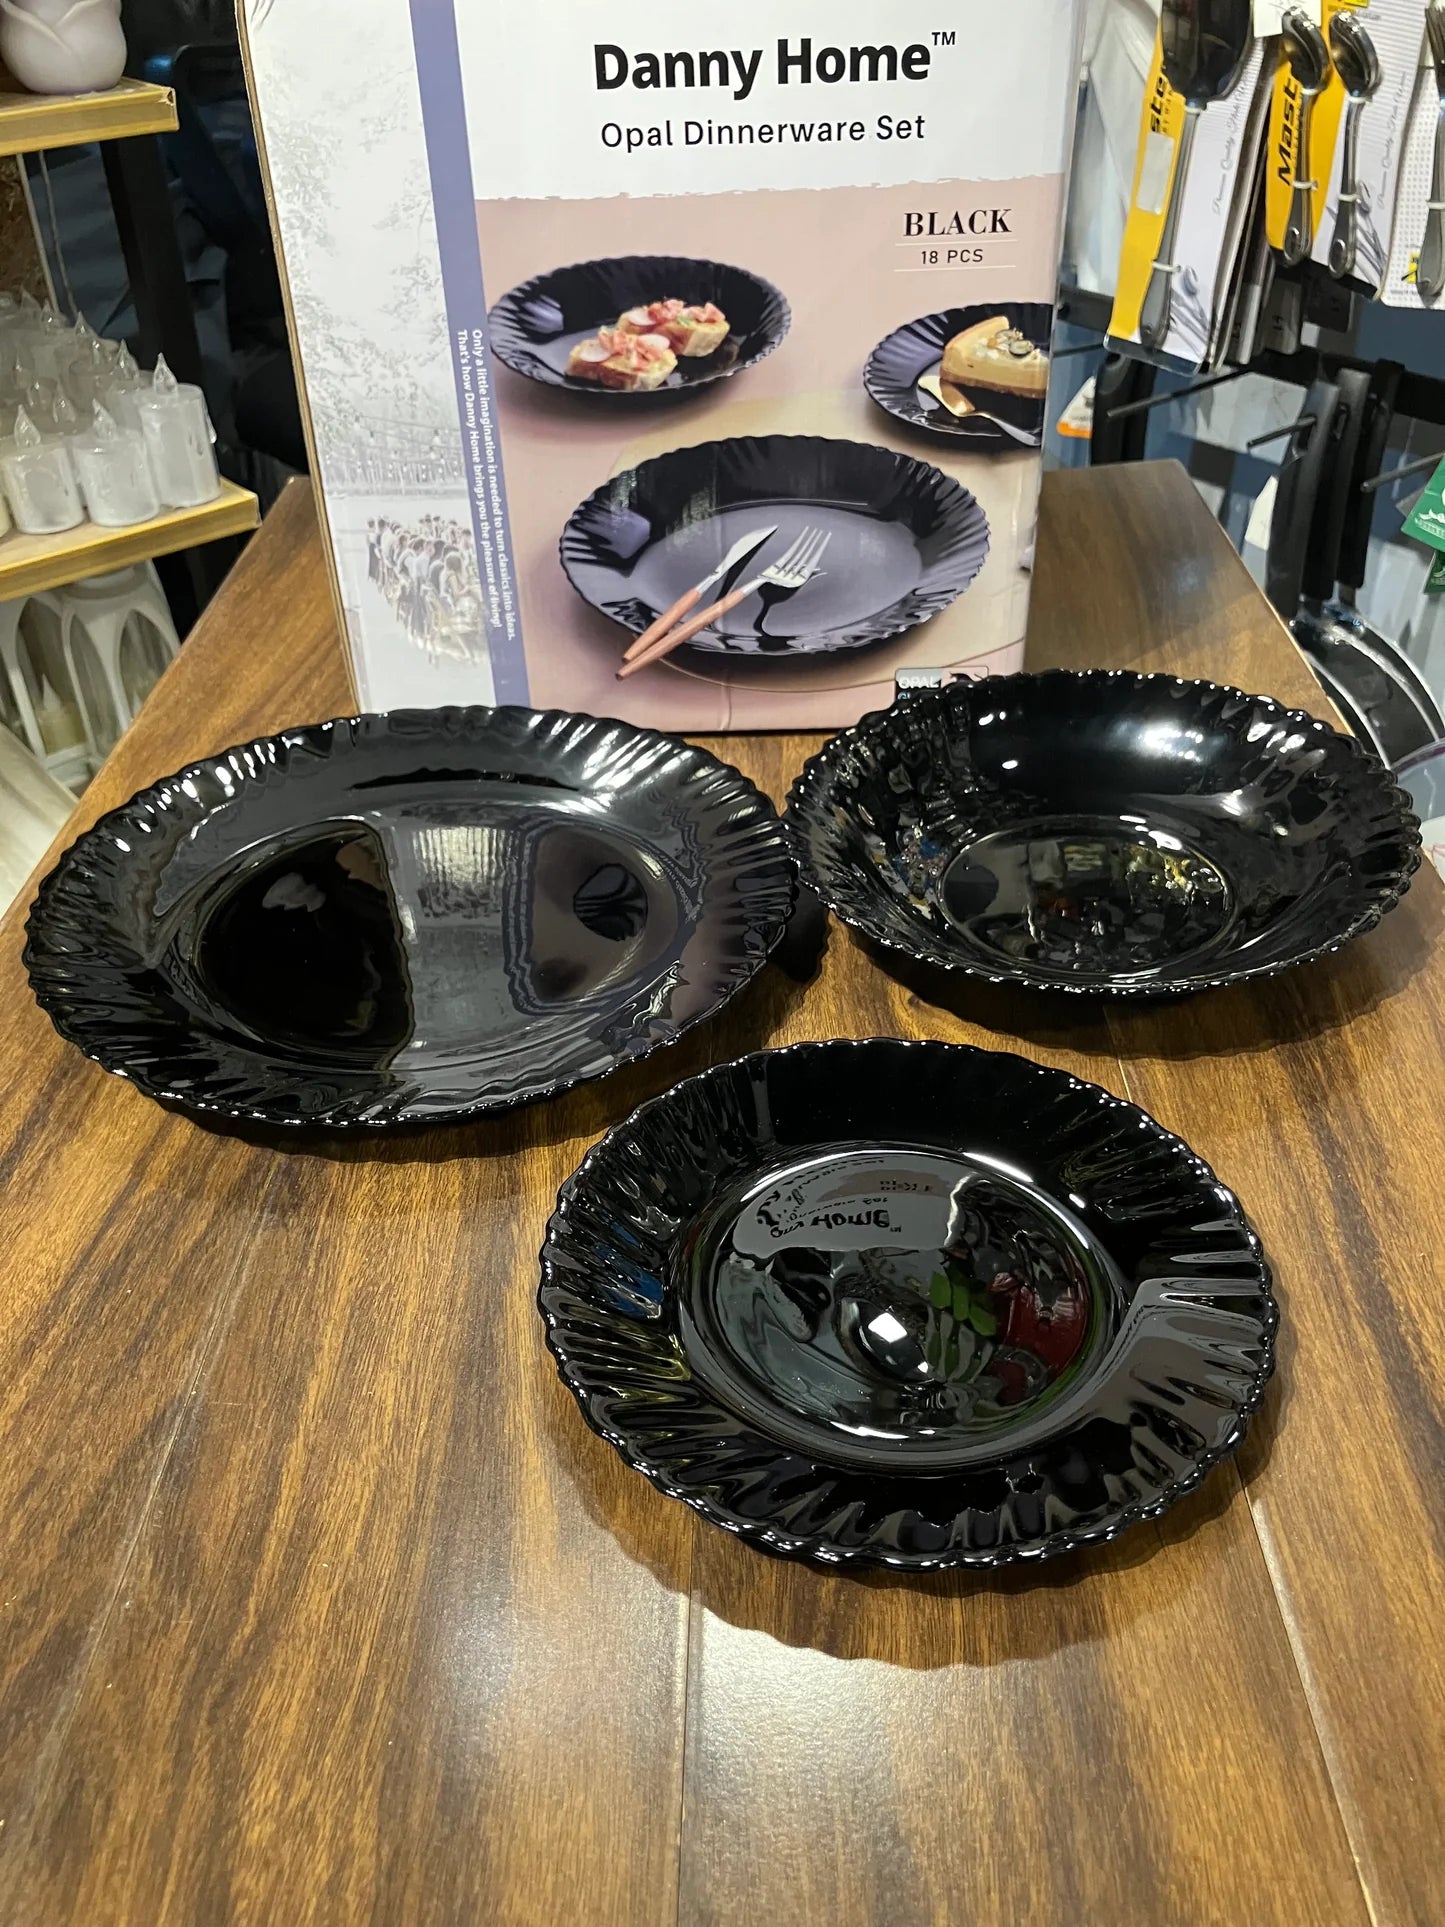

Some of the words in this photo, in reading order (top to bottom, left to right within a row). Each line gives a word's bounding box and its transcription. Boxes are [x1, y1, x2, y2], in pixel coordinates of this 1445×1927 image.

[594, 43, 764, 101] Danny
[777, 37, 931, 85] Home
[601, 119, 673, 153] Opal
[684, 118, 866, 146] Dinnerware
[876, 114, 925, 141] Set
[1278, 78, 1298, 186] Mast
[903, 208, 1012, 237] BLACK
[921, 249, 939, 265] 18
[947, 248, 984, 263] PCS
[458, 329, 471, 364] That's
[472, 329, 485, 357] Only
[462, 366, 472, 391] how
[476, 368, 489, 395] little
[465, 393, 476, 428] Danny
[480, 397, 495, 463] imagination
[470, 431, 480, 463] Home
[474, 465, 485, 499] brings
[489, 476, 503, 515] needed
[476, 500, 487, 520] you
[494, 517, 503, 528] to
[481, 521, 491, 539] the
[496, 530, 505, 551] turn
[480, 541, 495, 584] pleasure
[498, 553, 511, 589] classics
[503, 591, 513, 611] into
